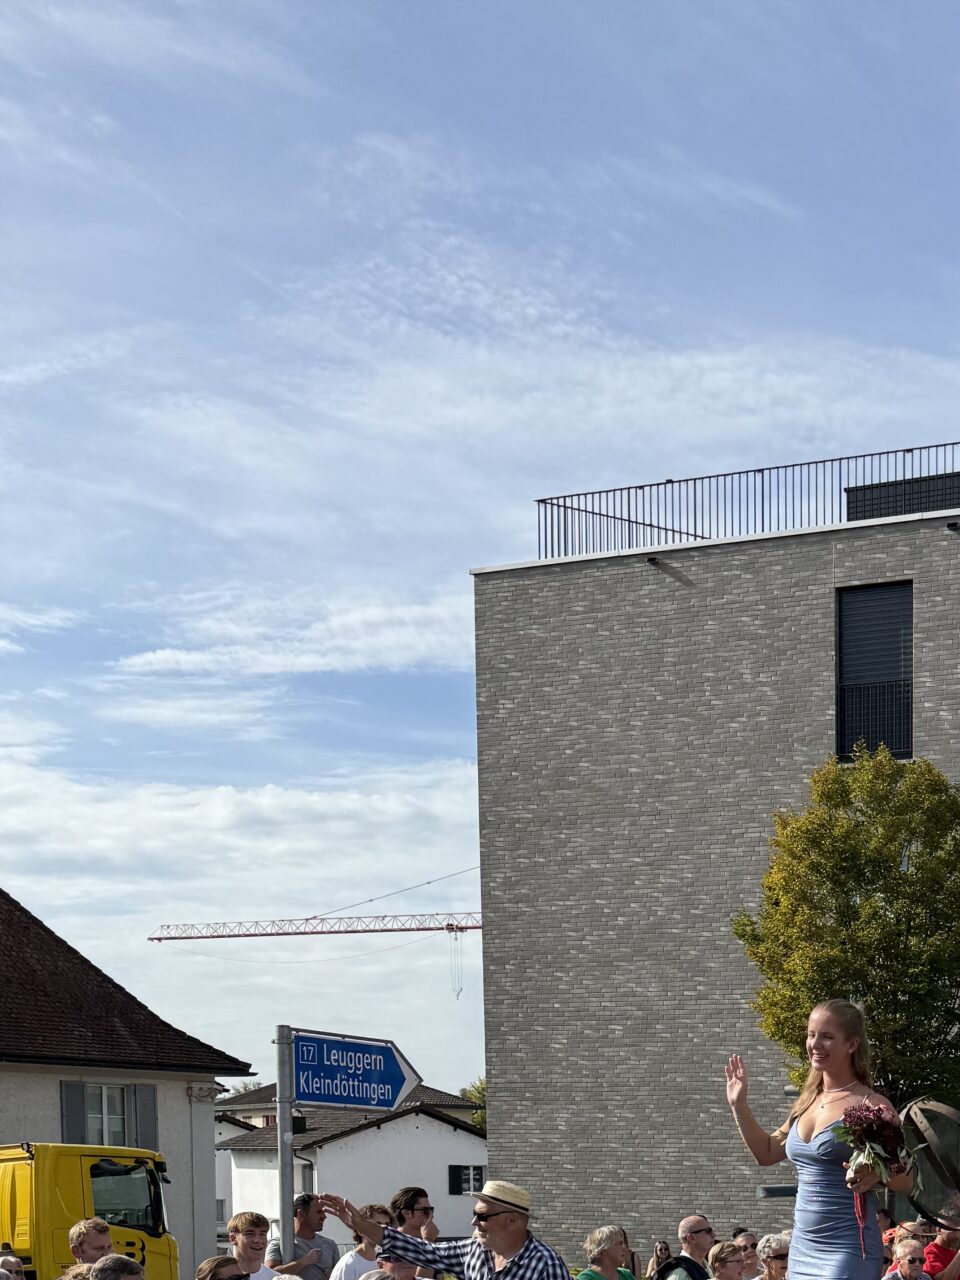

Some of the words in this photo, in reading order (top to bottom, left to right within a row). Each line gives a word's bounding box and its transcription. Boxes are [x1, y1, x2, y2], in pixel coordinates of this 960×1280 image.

[302, 1045, 314, 1061] 17
[323, 1043, 384, 1074] Leuggern
[300, 1070, 392, 1105] Kleindöttingen
